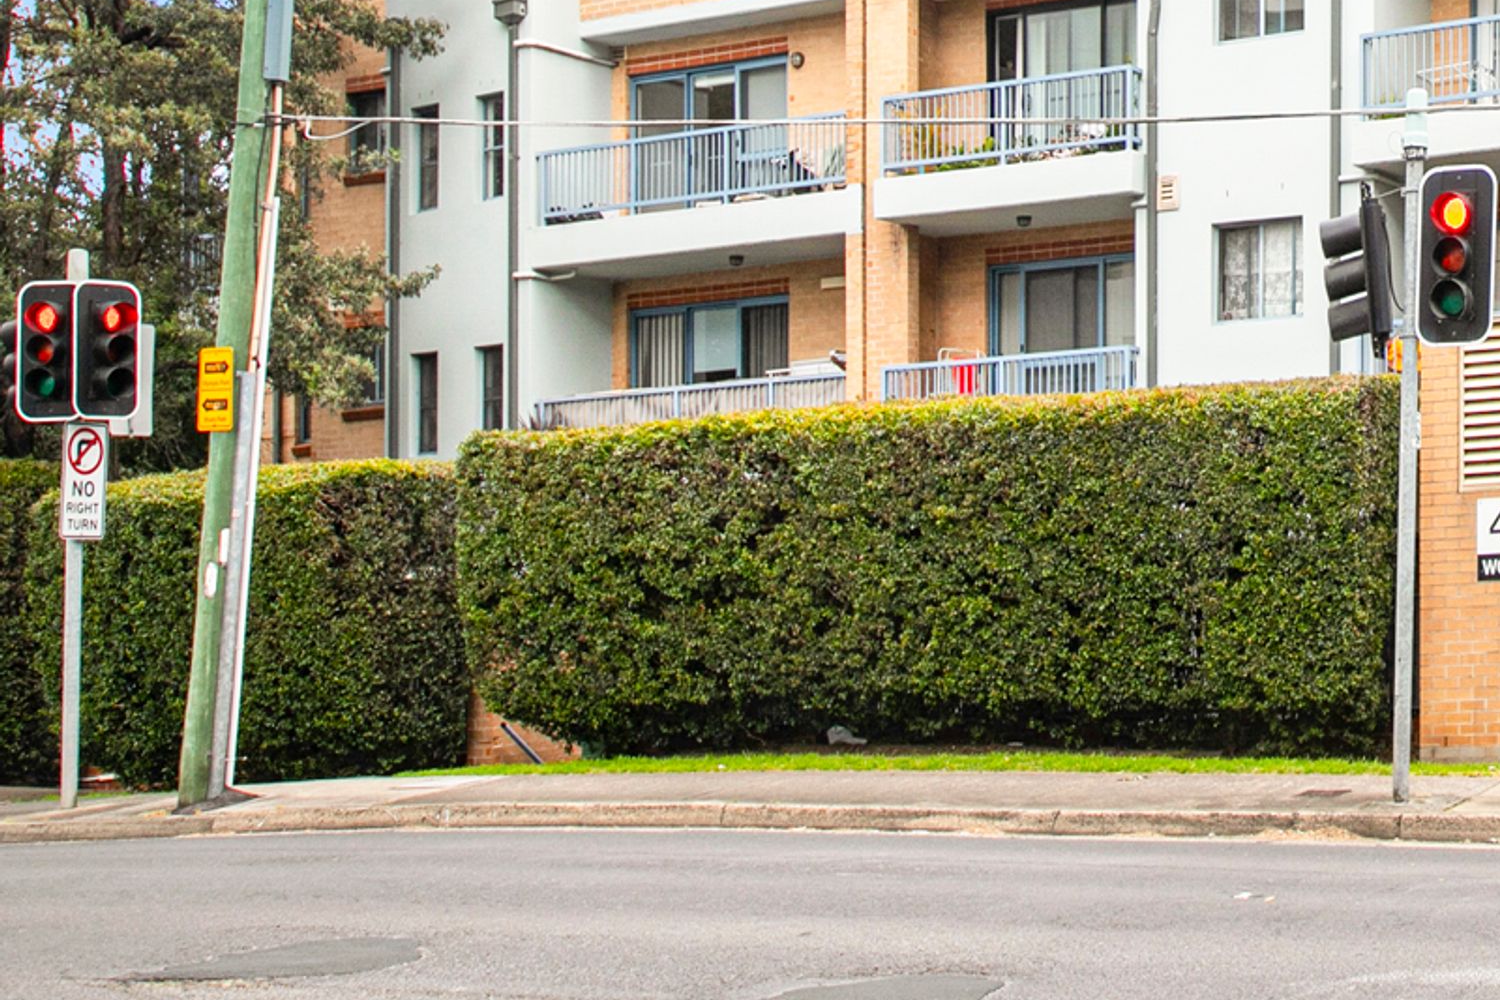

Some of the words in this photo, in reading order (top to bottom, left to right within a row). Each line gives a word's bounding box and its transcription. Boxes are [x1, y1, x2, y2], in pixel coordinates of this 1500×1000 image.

[72, 481, 95, 497] NO
[66, 502, 99, 514] RIGHT
[67, 518, 98, 530] TURN
